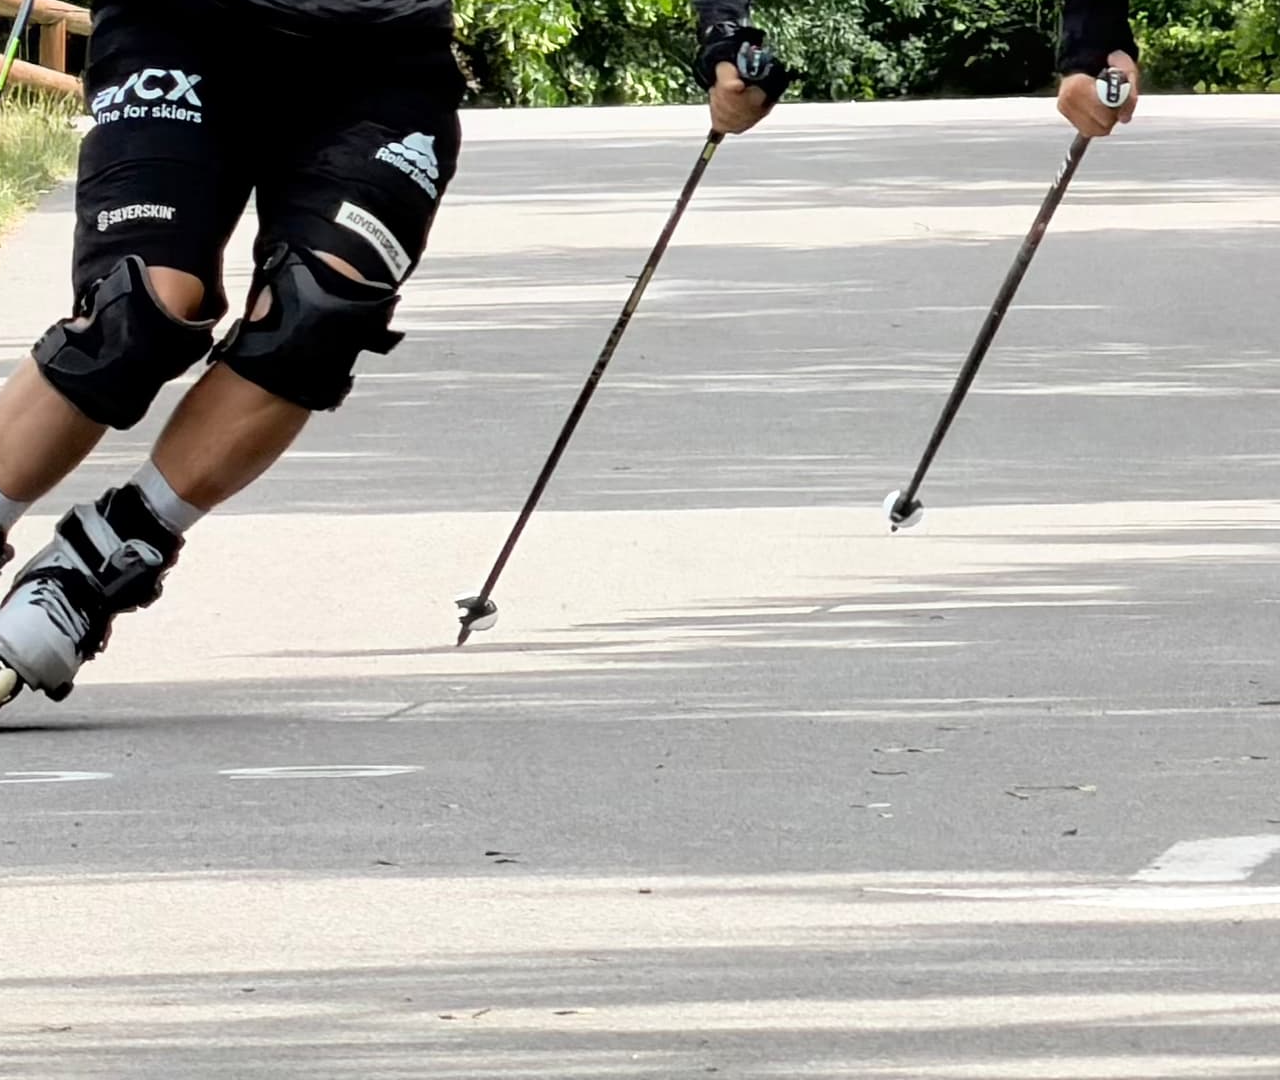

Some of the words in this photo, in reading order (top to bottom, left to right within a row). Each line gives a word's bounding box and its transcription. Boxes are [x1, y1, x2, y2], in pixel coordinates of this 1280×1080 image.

[91, 68, 202, 114] arcx
[123, 104, 148, 119] for
[151, 103, 202, 123] skiers
[109, 204, 173, 224] SILVERSKIN
